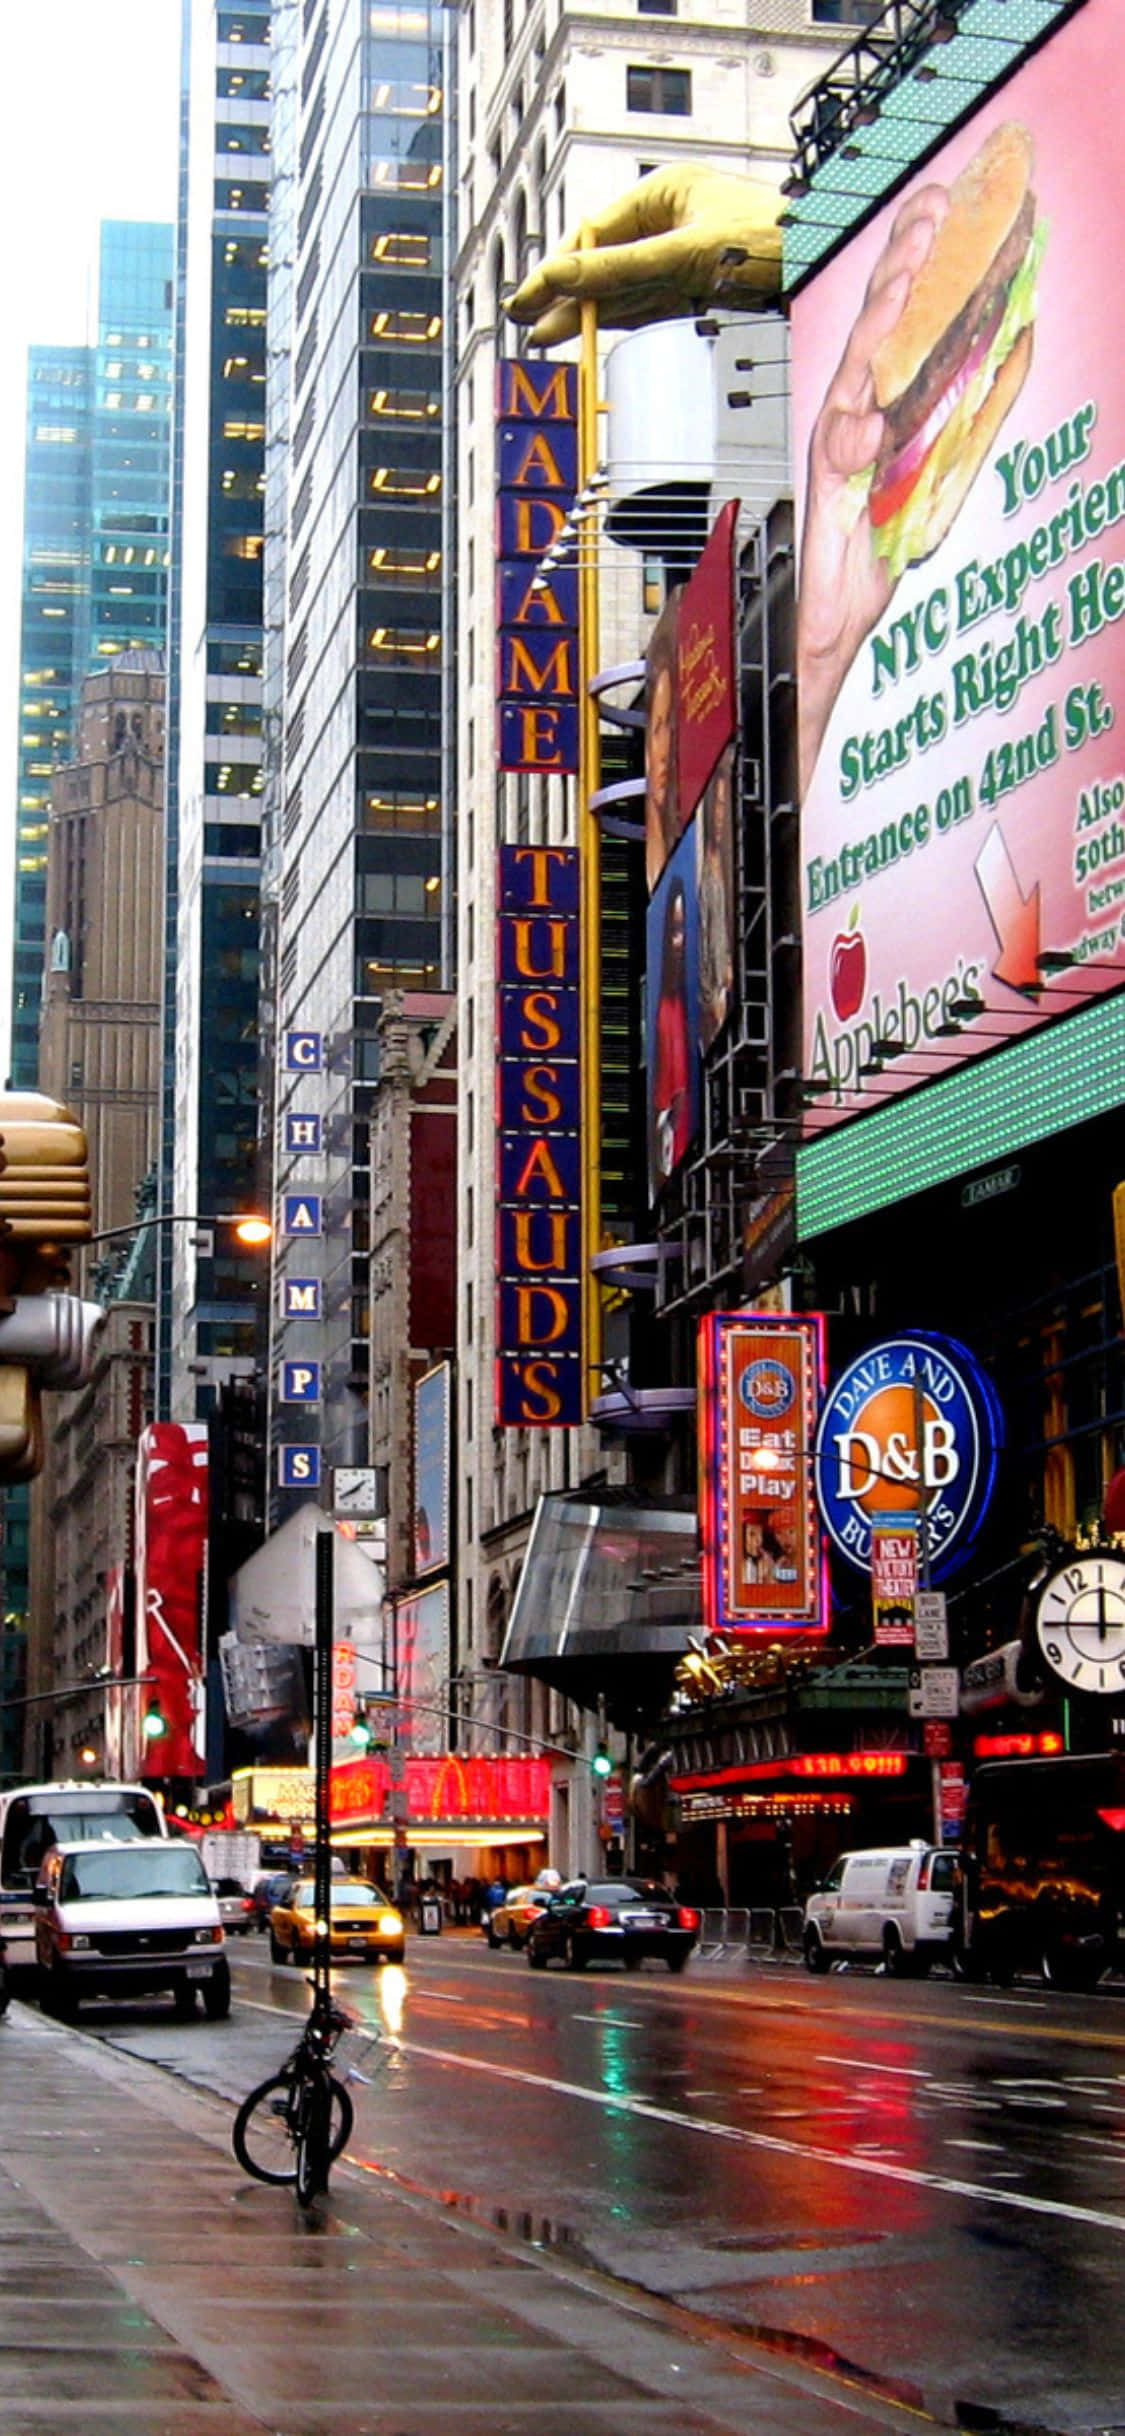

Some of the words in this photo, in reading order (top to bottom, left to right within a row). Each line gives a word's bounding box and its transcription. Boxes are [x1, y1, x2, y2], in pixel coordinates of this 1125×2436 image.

[995, 404, 1093, 513] Your
[508, 363, 573, 764] MADAME
[871, 588, 947, 693] NYC
[840, 693, 943, 796] Starts
[952, 605, 1060, 722] Right
[808, 808, 928, 911] Entrance
[937, 775, 972, 829] on
[980, 706, 1057, 804] 42nd
[1065, 684, 1112, 746] St.
[1076, 782, 1125, 832] Also
[1075, 821, 1125, 882] 50th
[809, 960, 978, 1104] Applebee's
[512, 848, 570, 1421] TUSSAUD'S
[291, 1038, 316, 1479] CHAMPS
[835, 1353, 892, 1419] DAVE
[901, 1352, 955, 1403] AND
[740, 1427, 796, 1449] Eat
[833, 1419, 960, 1499] D&B
[740, 1473, 796, 1500] Play
[880, 1538, 911, 1558] NEW
[1063, 1568, 1089, 1595] 12
